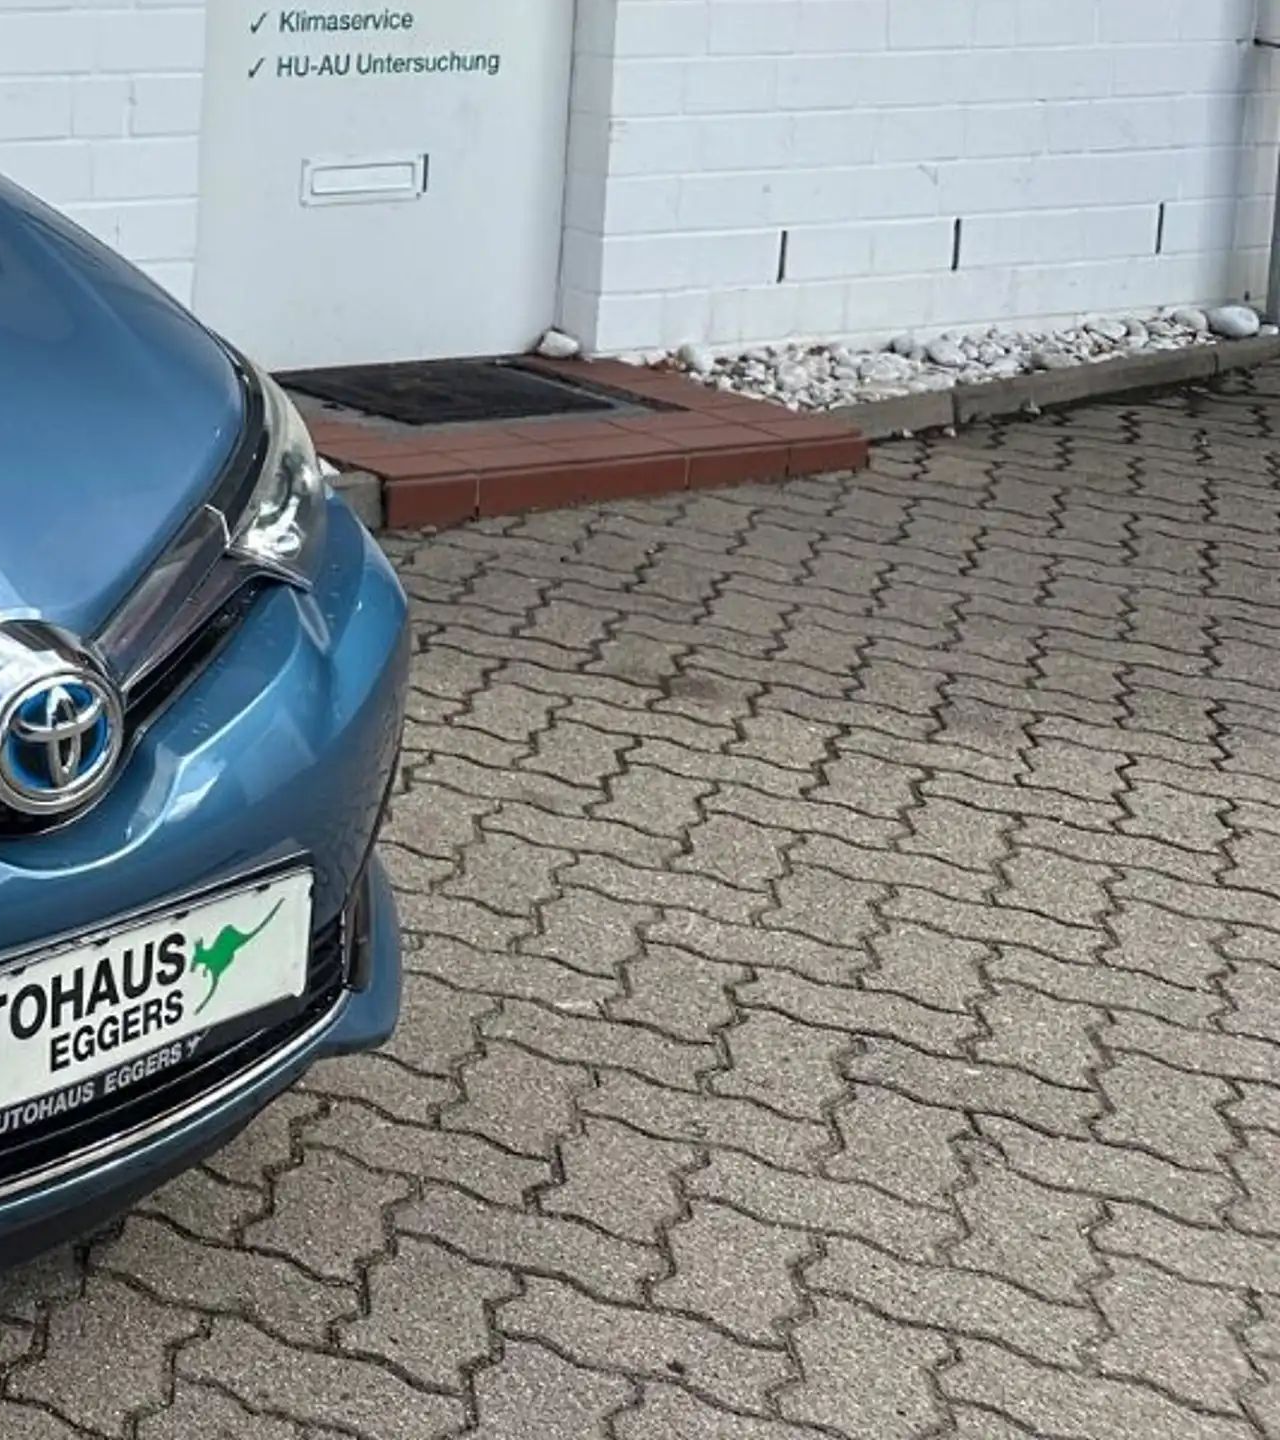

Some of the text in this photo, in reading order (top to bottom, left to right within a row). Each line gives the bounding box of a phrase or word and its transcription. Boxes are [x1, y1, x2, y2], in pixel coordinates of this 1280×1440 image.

[279, 7, 414, 33] Klimaservice
[276, 51, 501, 78] HU-AU Untersuchung
[50, 989, 184, 1073] EGGERS
[103, 1041, 183, 1095] EGGERS
